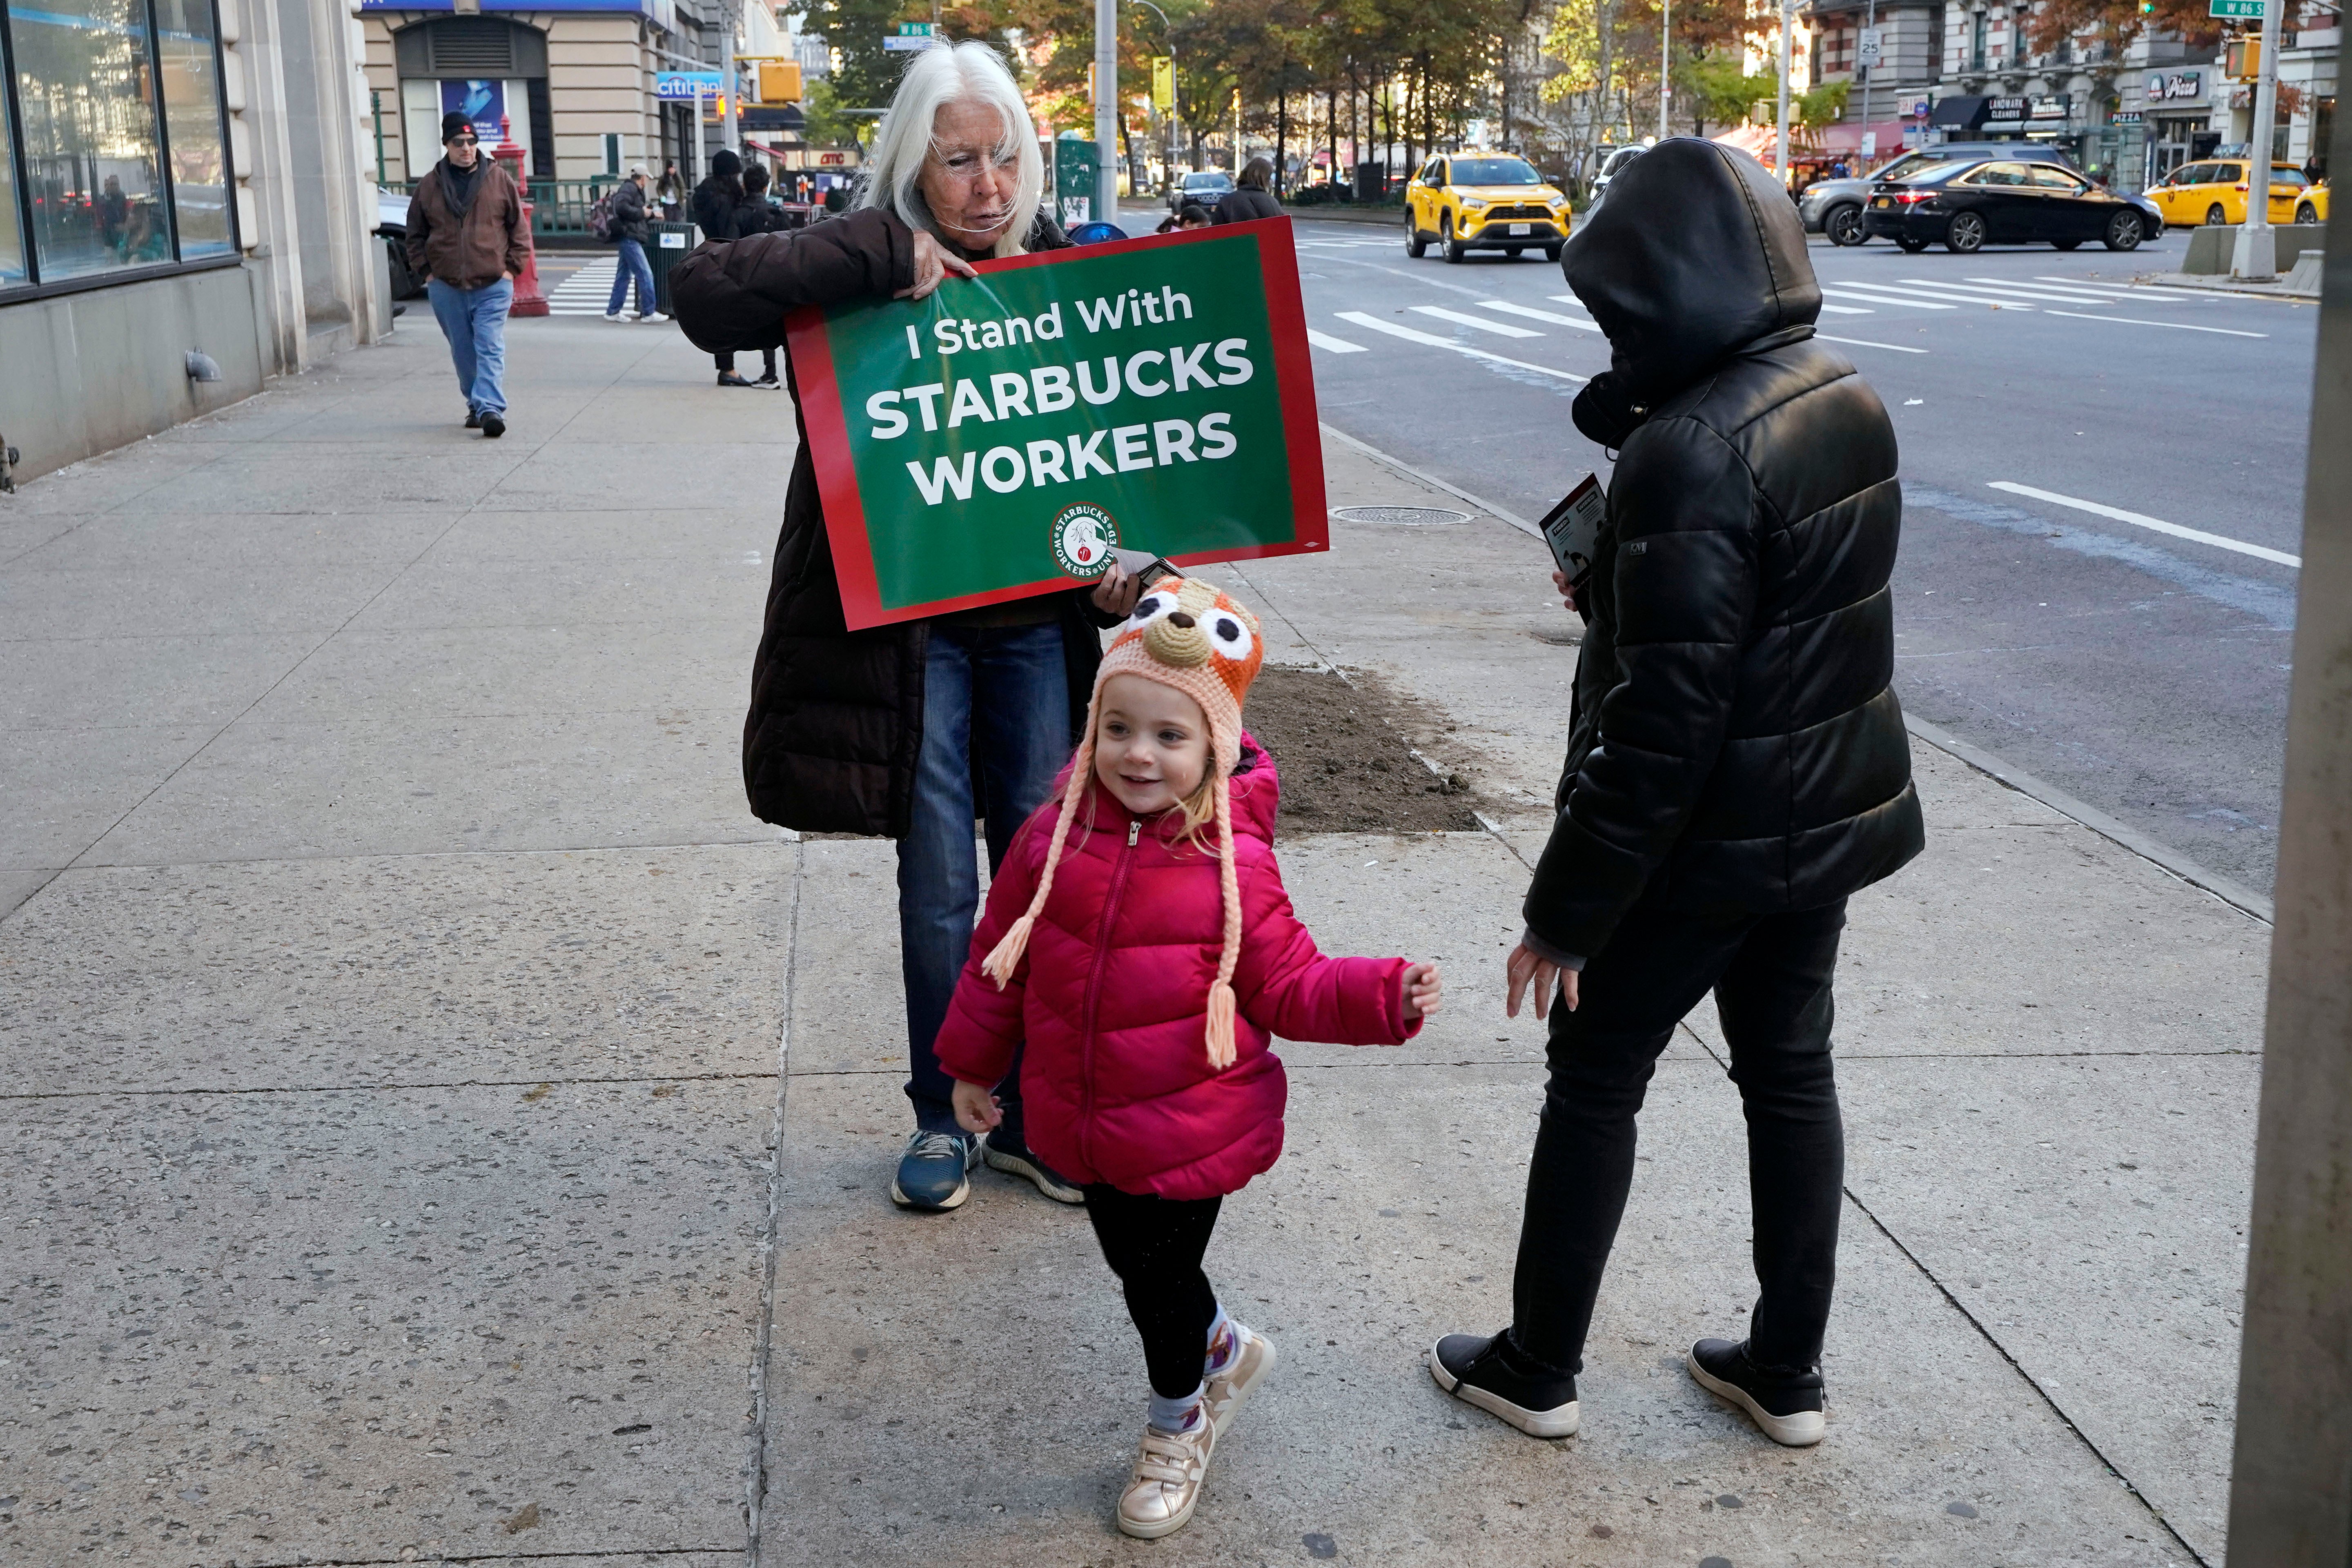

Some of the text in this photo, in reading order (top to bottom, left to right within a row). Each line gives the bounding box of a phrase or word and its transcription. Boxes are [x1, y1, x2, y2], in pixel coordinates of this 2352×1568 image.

[2227, 2, 2263, 15] W 86 S
[900, 24, 909, 35] W
[912, 24, 922, 35] 86
[1862, 44, 1878, 53] 25
[2165, 75, 2197, 98] Pizza
[1989, 98, 2023, 109] LANDMARK
[1991, 110, 2020, 119] CLEANERS
[2112, 113, 2141, 122] PIZZA
[906, 285, 1193, 359] I Stand With
[866, 338, 1254, 439] STARBUCKS
[905, 412, 1237, 506] WORKERS
[1055, 506, 1109, 532] STARBUCKS
[1054, 538, 1092, 576] WORKERS
[1097, 530, 1117, 572] UNIED
